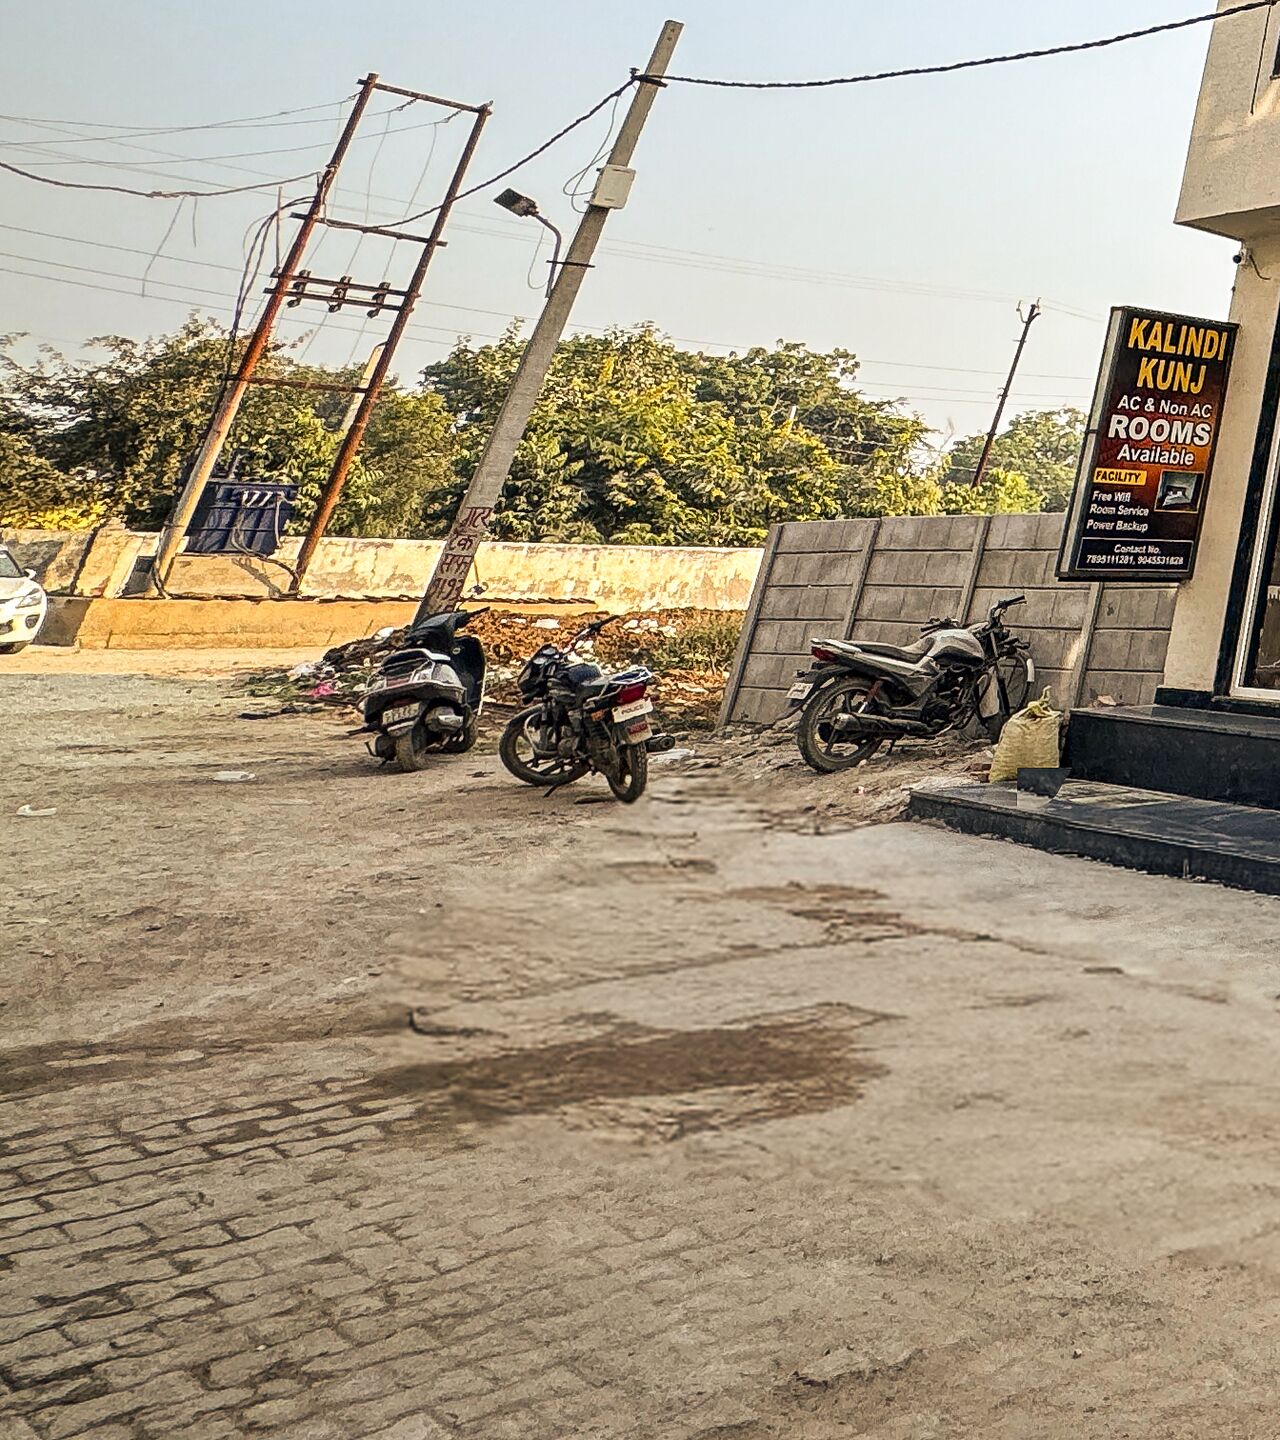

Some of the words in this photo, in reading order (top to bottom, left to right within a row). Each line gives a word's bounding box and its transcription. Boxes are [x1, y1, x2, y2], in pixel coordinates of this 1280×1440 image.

[1128, 318, 1228, 361] KALINDI
[1137, 357, 1207, 394] KUNJ
[1118, 395, 1141, 410] AC
[1144, 398, 1155, 412] &
[1159, 400, 1188, 415] Non
[1190, 404, 1212, 418] AC
[1108, 414, 1211, 446] ROOMS
[1117, 444, 1195, 466] Available
[1095, 470, 1142, 484] FACILITY
[1092, 490, 1113, 502] Free
[1089, 504, 1116, 515] Room
[1117, 505, 1150, 517] Service
[1086, 520, 1116, 531] Power
[1116, 521, 1149, 534] Backup
[1114, 544, 1146, 554] Contact
